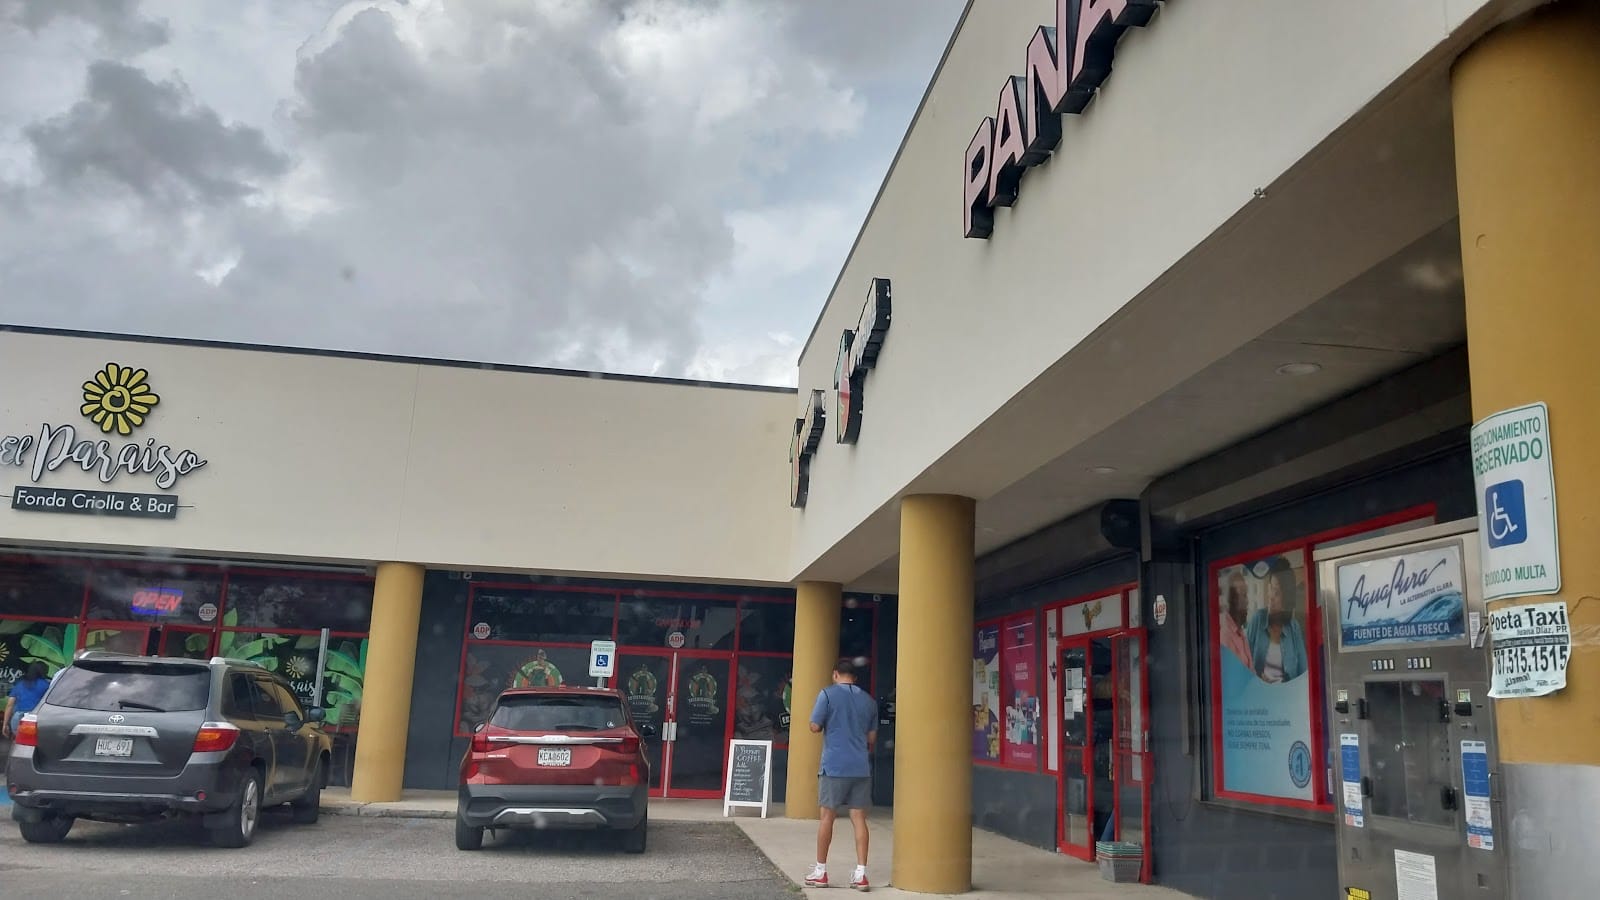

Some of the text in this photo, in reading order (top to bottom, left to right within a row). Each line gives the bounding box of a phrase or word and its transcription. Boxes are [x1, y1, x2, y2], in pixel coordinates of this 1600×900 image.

[1473, 416, 1541, 454] ESTACIONAMIENTO
[0, 434, 34, 467] El
[1475, 437, 1543, 476] RESERVADO
[16, 489, 174, 513] Fonda Criolla & Bar
[1514, 564, 1547, 580] MULTA
[131, 591, 183, 613] OPEN
[1489, 611, 1522, 632] Poeta
[1524, 605, 1566, 627] Taxi
[1556, 625, 1568, 633] PR
[1353, 623, 1450, 640] FUENTE DE AGUA FRESCA
